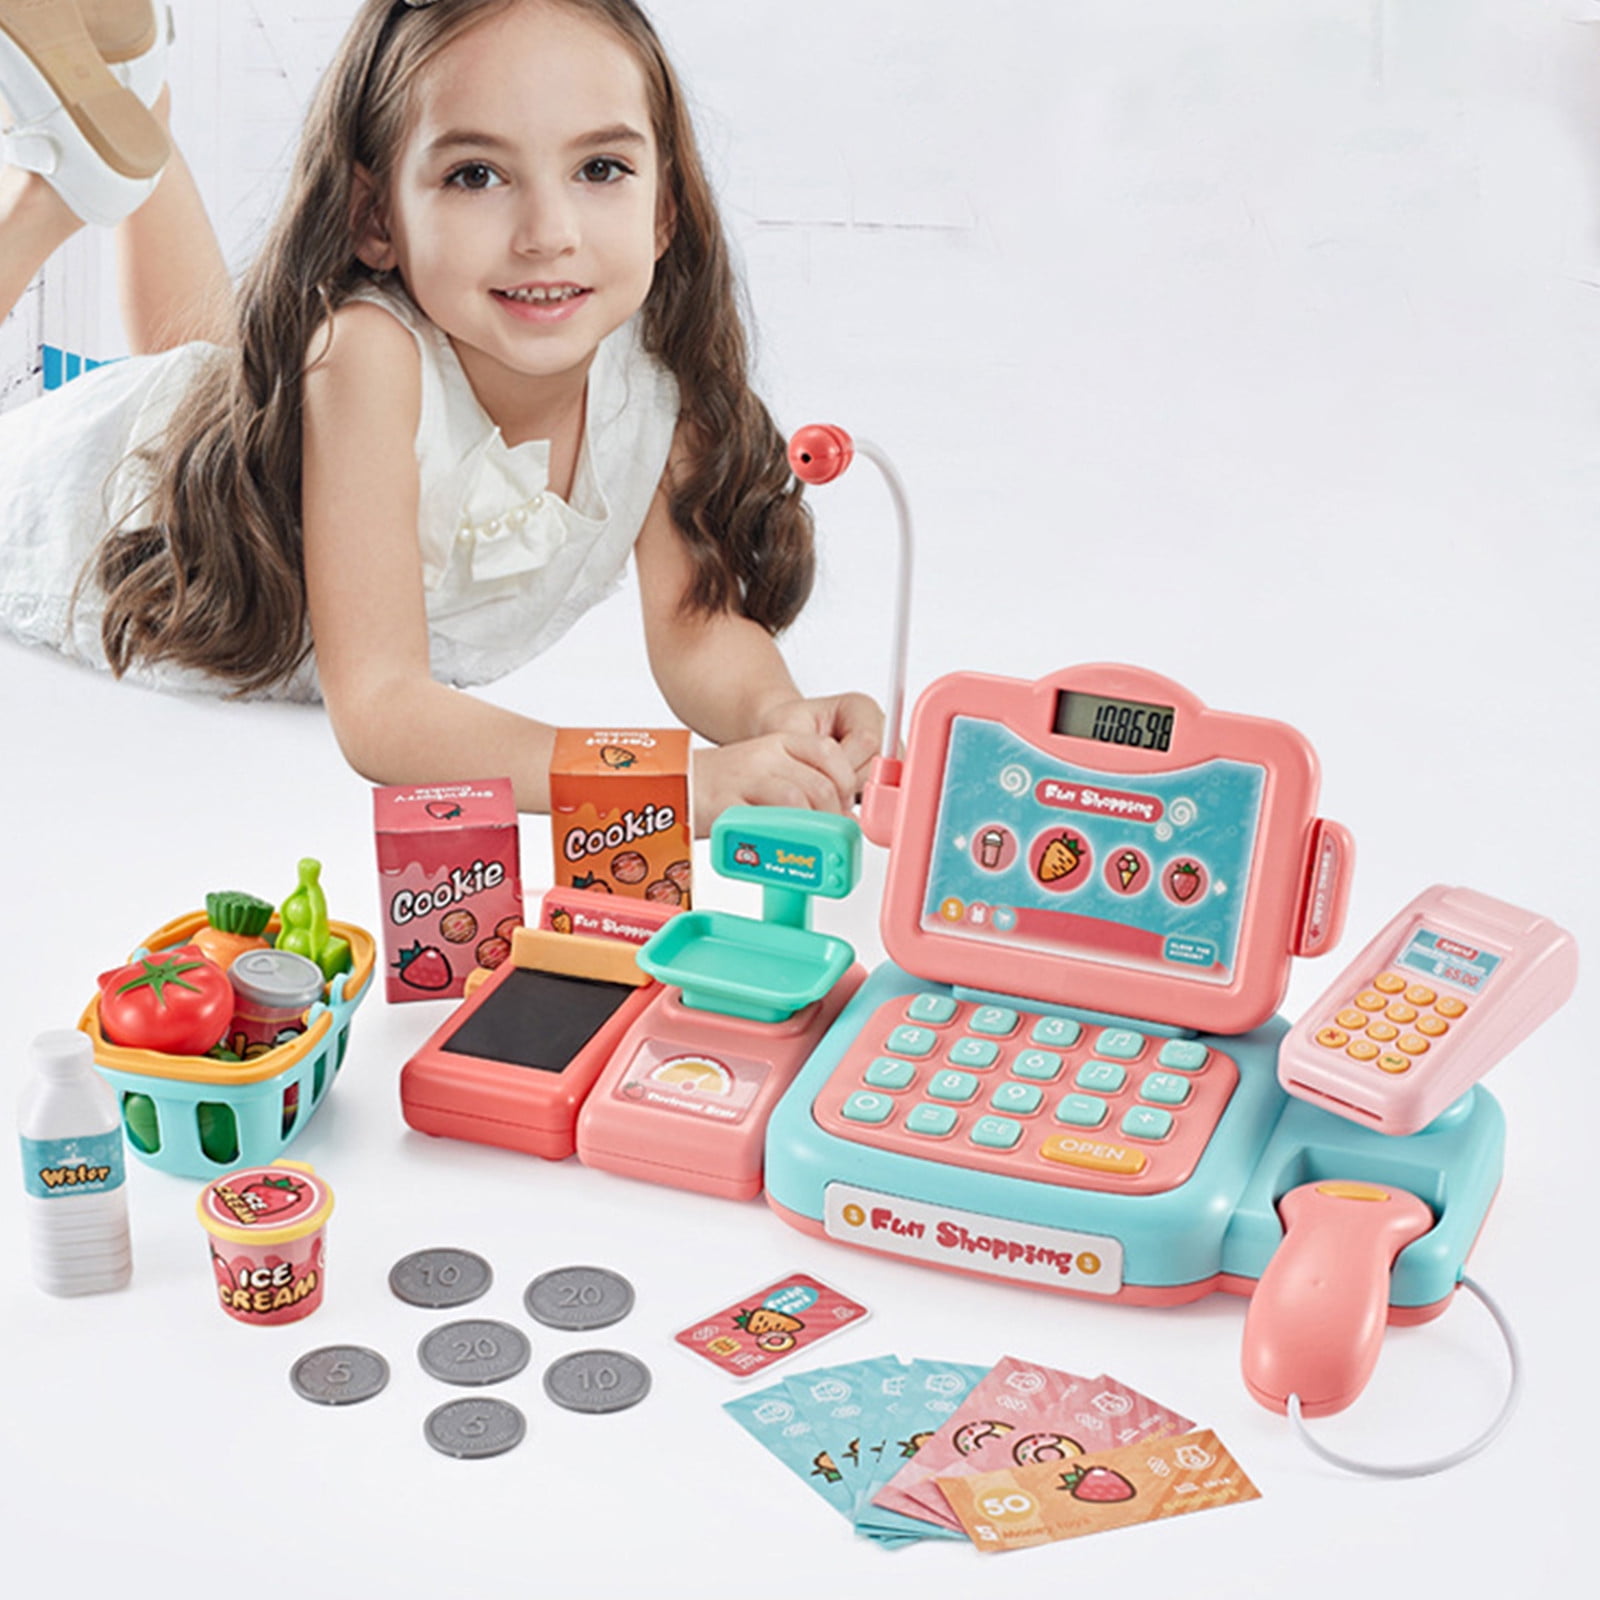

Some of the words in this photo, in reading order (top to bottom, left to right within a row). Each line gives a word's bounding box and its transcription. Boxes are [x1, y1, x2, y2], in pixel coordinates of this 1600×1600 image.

[394, 790, 494, 803] Strawberry
[1044, 783, 1077, 802] Fun
[1080, 789, 1154, 819] Shopping
[564, 804, 675, 862] Cookie
[390, 859, 505, 926] Cookie
[573, 913, 599, 929] Fun
[925, 998, 938, 1012] 1
[983, 1009, 1003, 1024] 2
[901, 1029, 921, 1044] 4
[1045, 1019, 1064, 1035] 3
[963, 1042, 983, 1056] 5
[1026, 1053, 1045, 1068] 6
[881, 1061, 899, 1076] 7
[942, 1075, 962, 1089] 8
[1007, 1085, 1027, 1100] 9
[981, 1120, 1010, 1136] CE
[1059, 1138, 1126, 1161] OPEN
[212, 1185, 258, 1225] CREAM
[241, 1191, 268, 1211] ICE
[871, 1207, 925, 1239] Fun
[936, 1220, 1073, 1276] Shopping
[239, 1261, 295, 1291] ICE
[420, 1263, 460, 1287] 10
[218, 1269, 319, 1315] CREAM
[556, 1285, 603, 1308] 20
[451, 1337, 498, 1363] 20
[325, 1361, 351, 1384] 5
[576, 1367, 618, 1390] 10
[459, 1415, 492, 1438] 5
[983, 1493, 1031, 1516] 50
